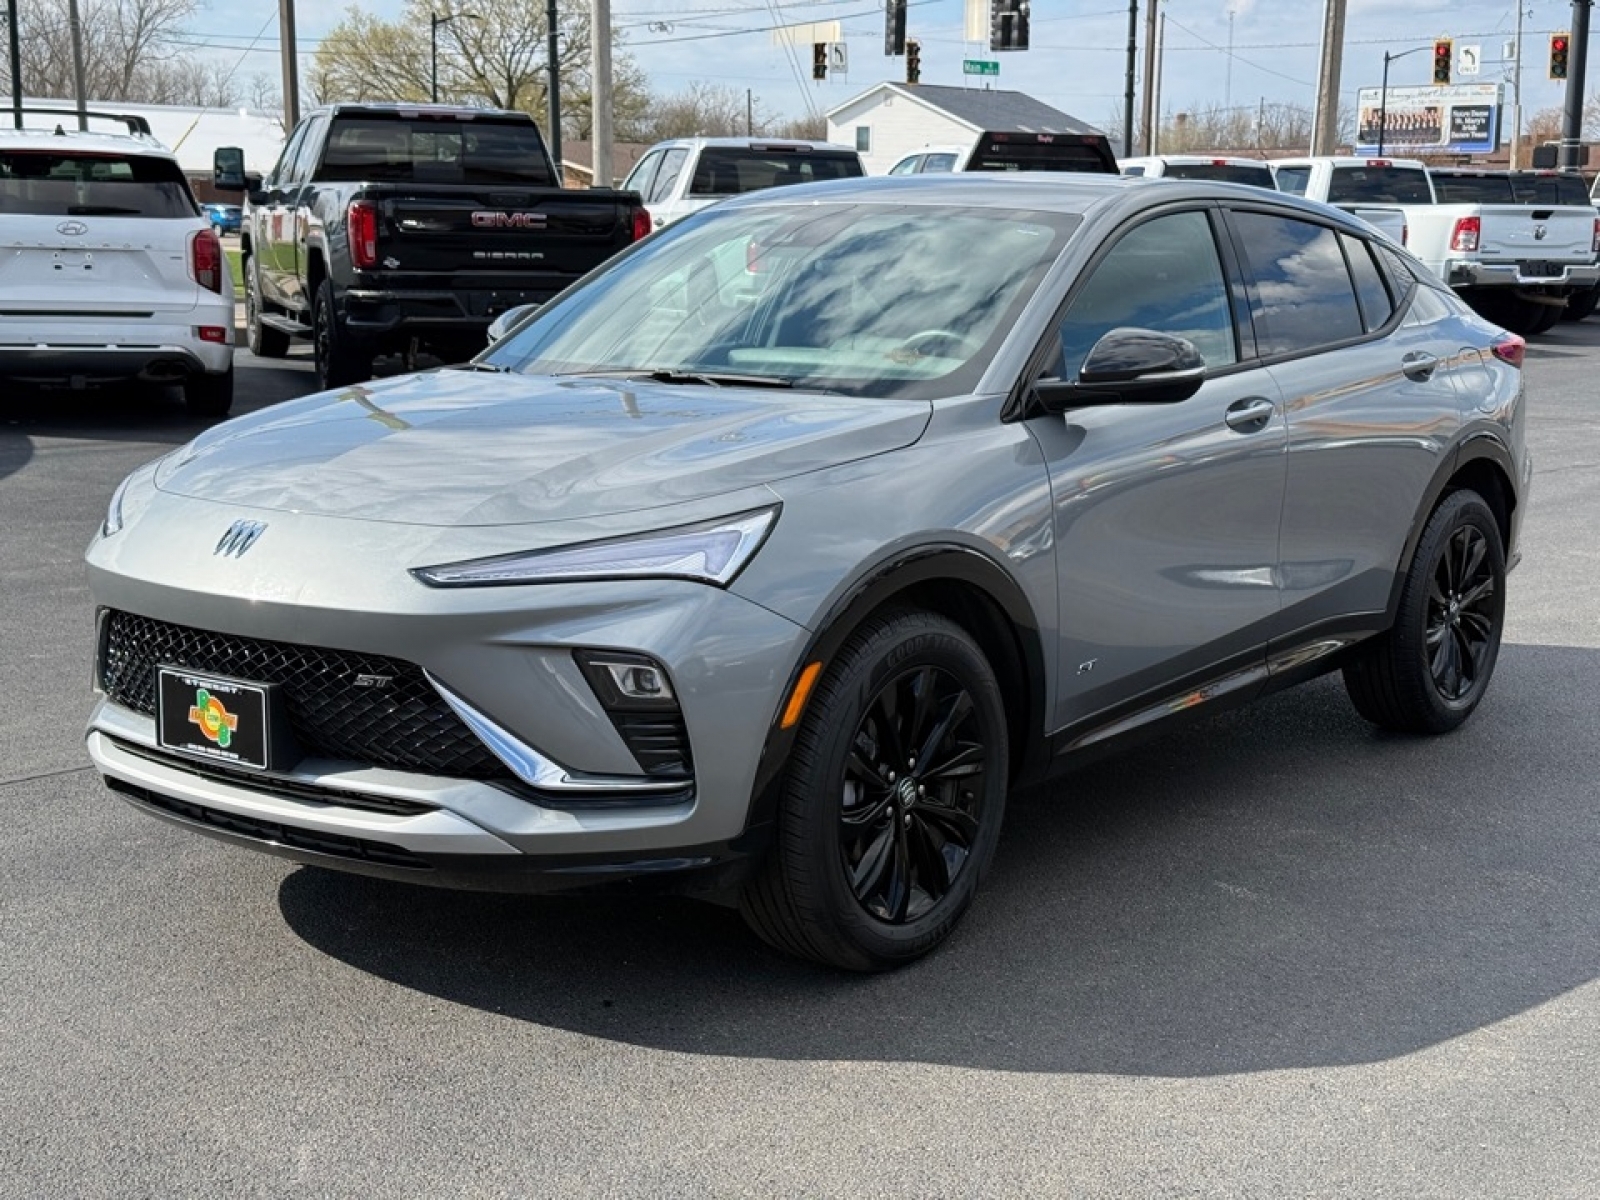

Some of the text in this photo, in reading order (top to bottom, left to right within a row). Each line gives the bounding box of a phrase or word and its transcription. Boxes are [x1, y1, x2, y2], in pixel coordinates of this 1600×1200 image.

[964, 62, 982, 73] Main
[471, 211, 547, 228] GMC
[473, 251, 544, 259] SIERRA
